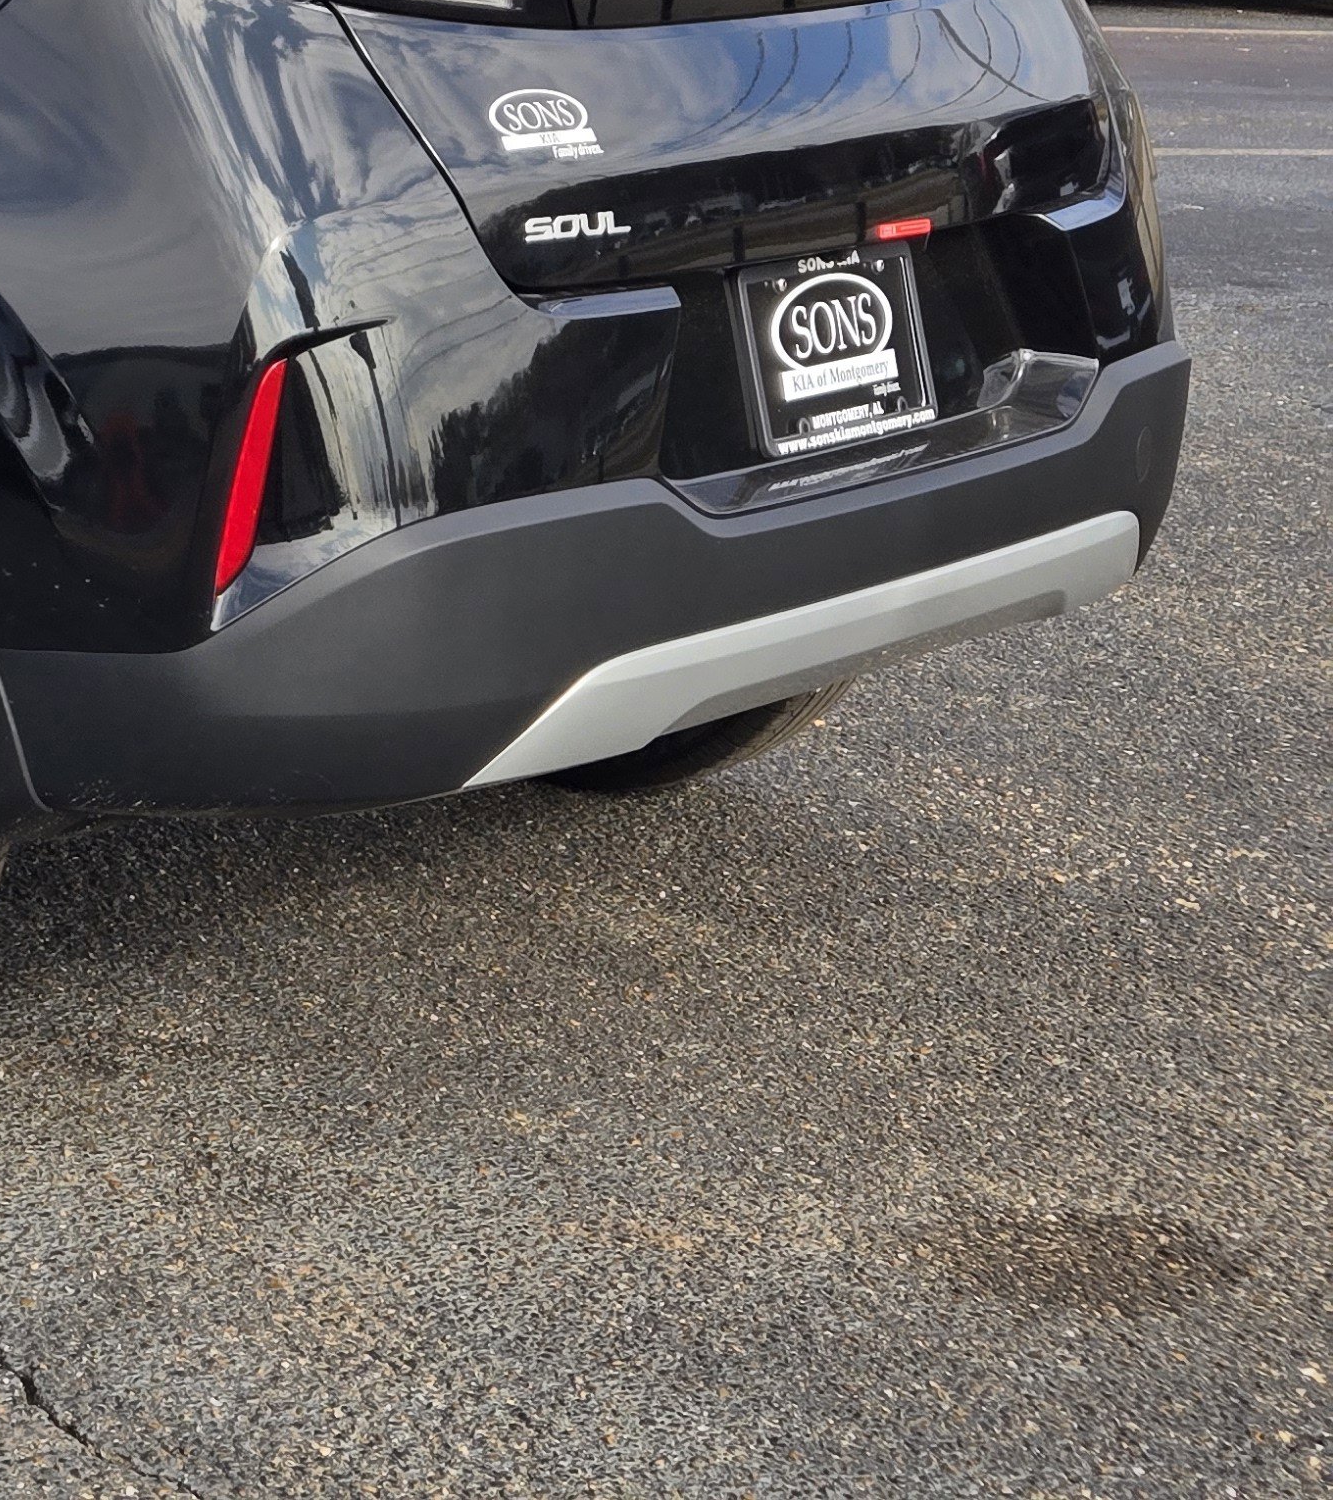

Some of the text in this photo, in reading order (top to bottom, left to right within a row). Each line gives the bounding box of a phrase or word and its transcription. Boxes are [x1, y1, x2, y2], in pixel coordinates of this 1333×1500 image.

[502, 98, 575, 132] SONS
[538, 133, 561, 145] KIA
[524, 210, 632, 244] SOUL
[791, 292, 877, 359] SONS
[792, 360, 889, 393] KIA of Montgomery
[777, 408, 936, 456] www.sonskiamontgomery.com
